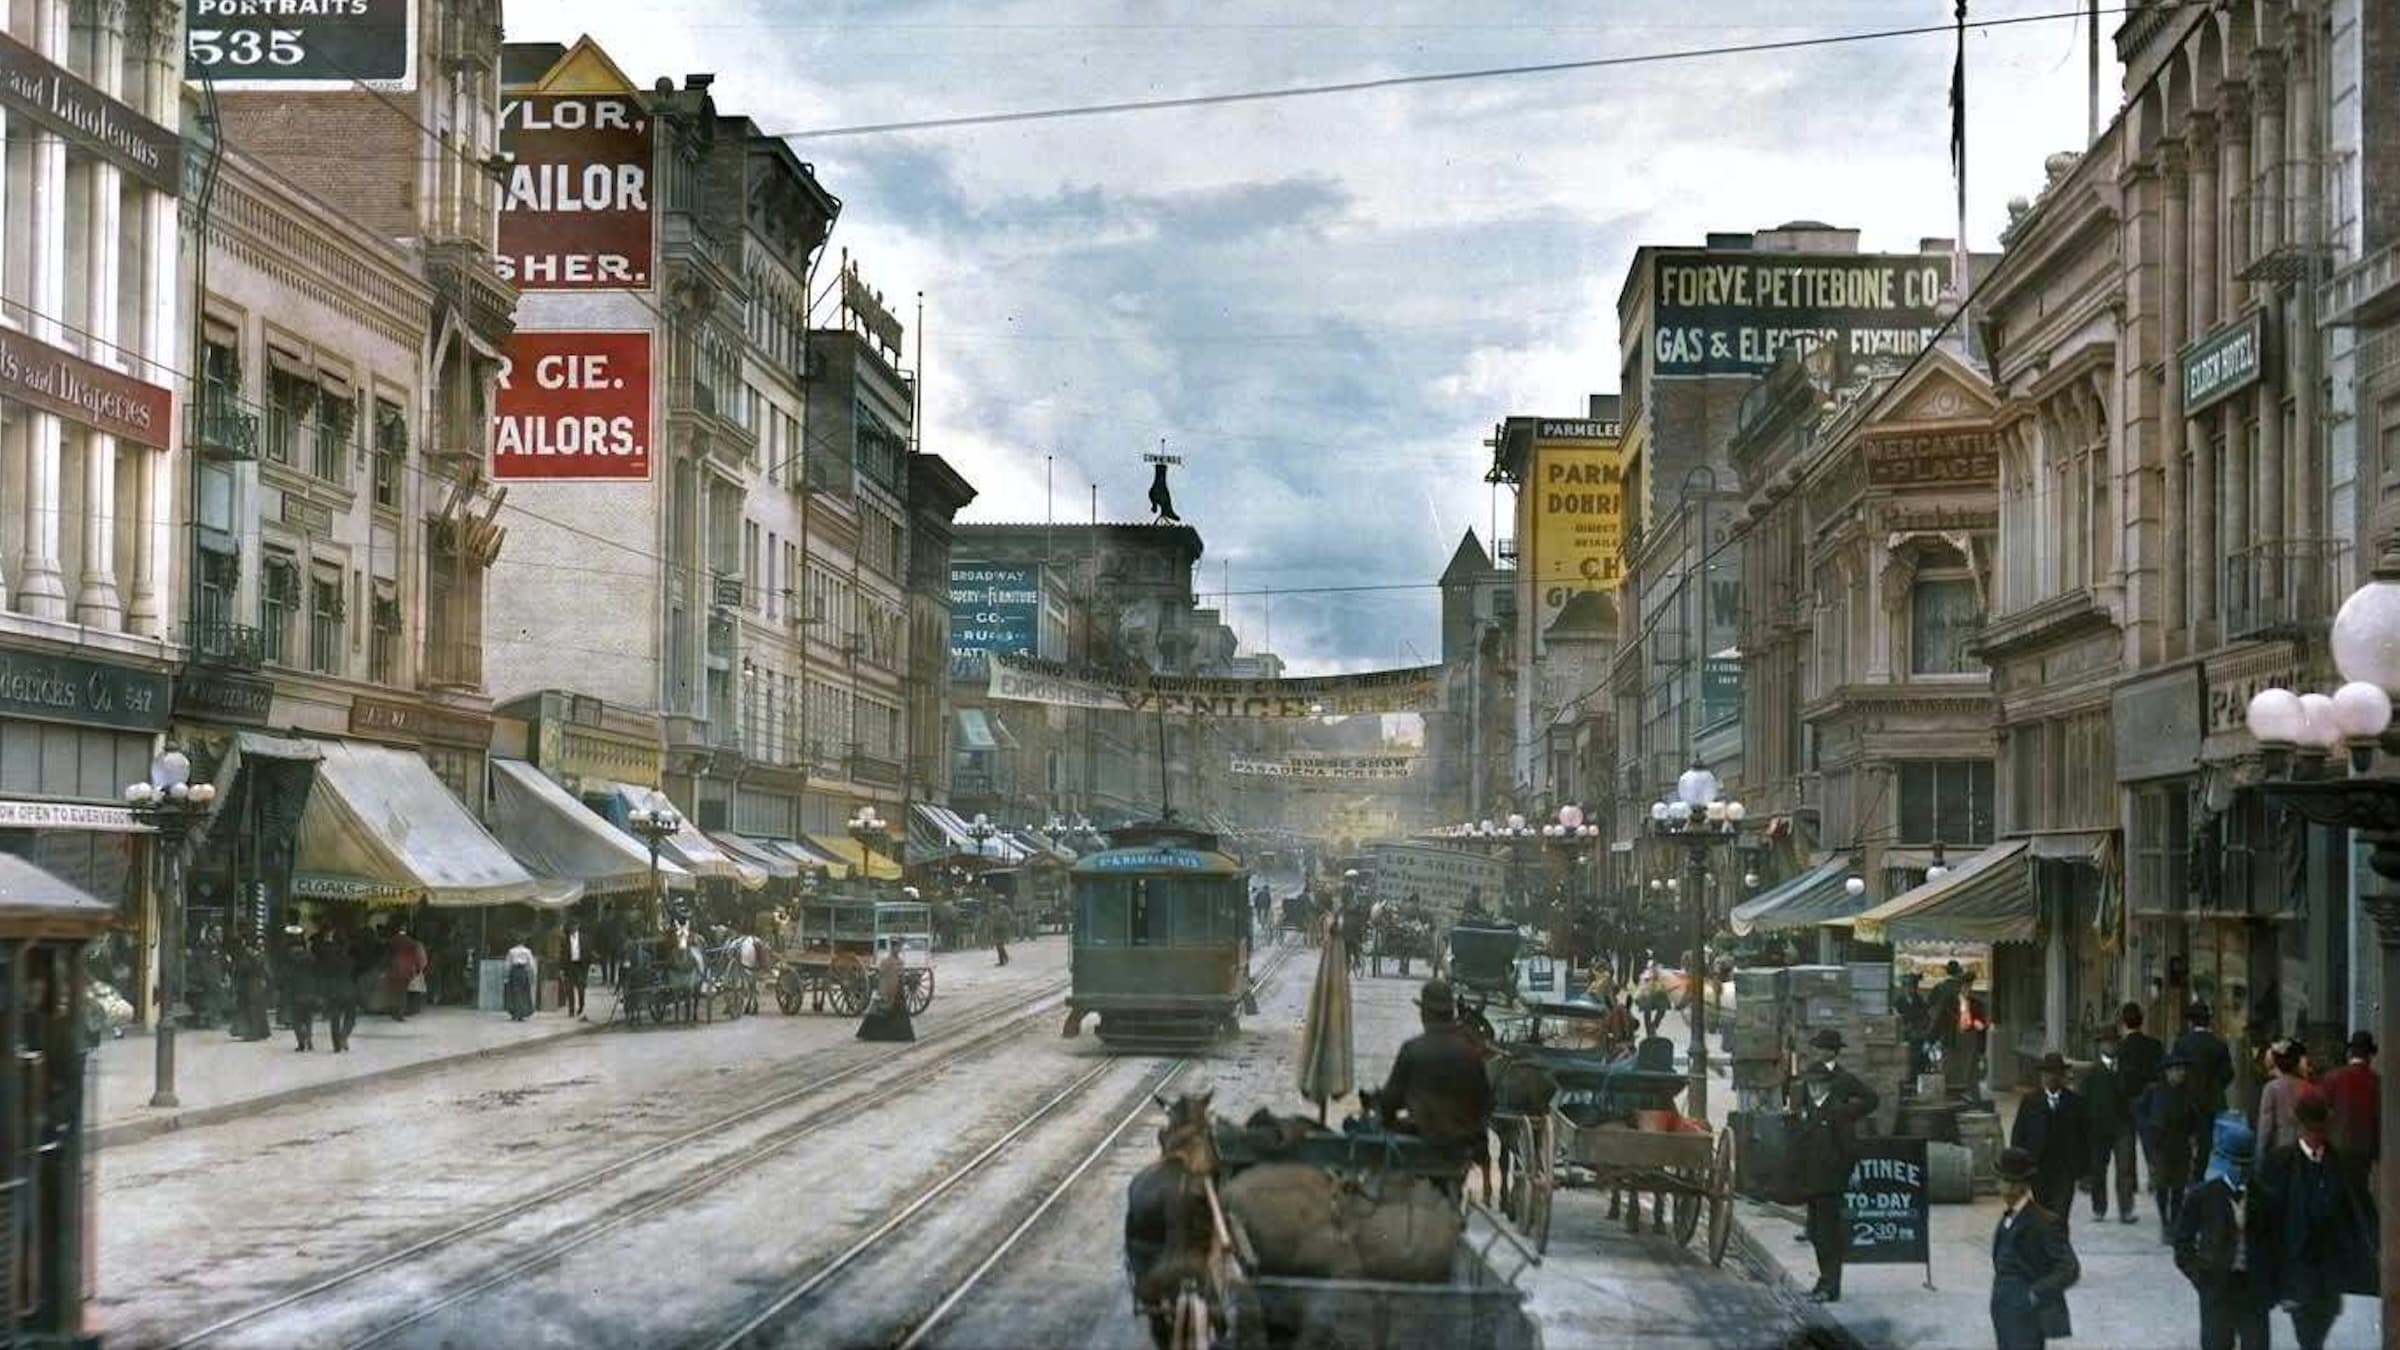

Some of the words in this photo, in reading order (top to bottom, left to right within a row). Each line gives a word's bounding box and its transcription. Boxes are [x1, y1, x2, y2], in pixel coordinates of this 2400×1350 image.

[198, 0, 368, 15] PORTRAITS
[188, 29, 305, 65] 535
[52, 76, 159, 169] Linoleums
[1756, 267, 1895, 309] PETTEBONE
[1655, 327, 1704, 363] GAS
[1710, 331, 1732, 359] &
[1850, 327, 1942, 356] FIXTURE
[536, 354, 625, 389] CIE.
[56, 360, 150, 428] Draperies
[951, 570, 1026, 581] BROADWAY
[1357, 756, 1409, 768] SHOW
